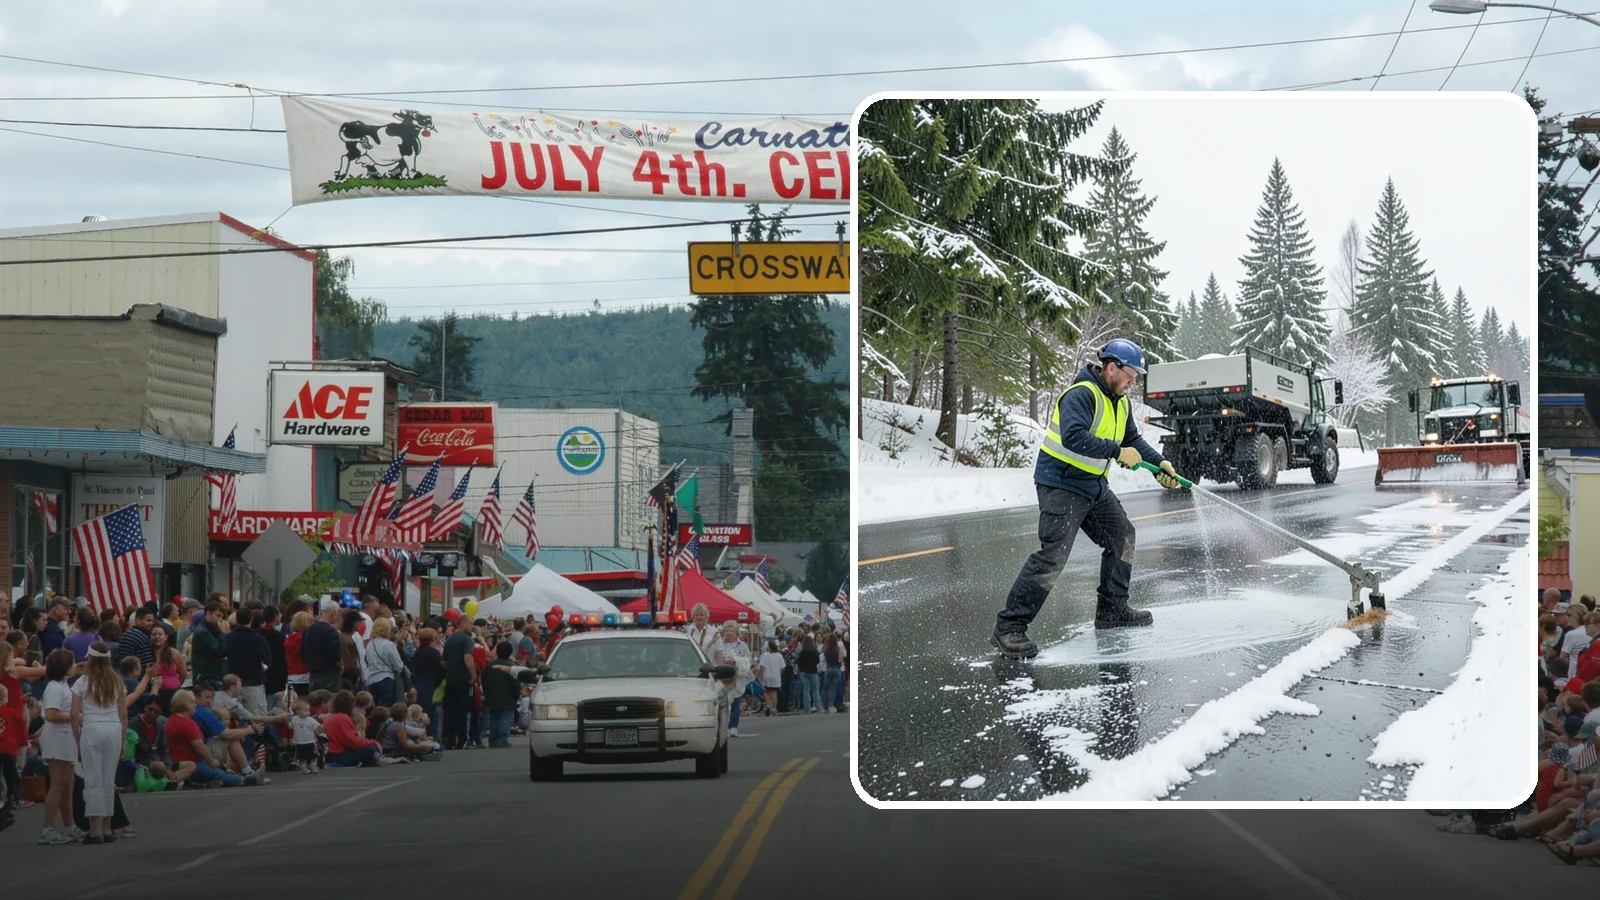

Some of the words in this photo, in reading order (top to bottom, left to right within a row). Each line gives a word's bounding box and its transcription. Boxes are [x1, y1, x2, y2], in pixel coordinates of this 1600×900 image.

[695, 121, 850, 150] Carnat
[481, 141, 605, 192] JULY
[632, 150, 746, 197] 4th.
[697, 254, 850, 280] CROSSWA
[283, 380, 373, 420] ACE
[406, 409, 452, 422] CEDAR
[461, 409, 485, 422] LOG
[283, 421, 370, 436] Hardware
[416, 428, 476, 446] Coca-Cola
[83, 485, 94, 494] St.
[95, 485, 124, 495] Vincent
[126, 486, 136, 495] de
[137, 486, 155, 495] Paul
[81, 503, 154, 522] THT
[213, 516, 331, 536] HARDARE
[688, 527, 741, 535] CRNATION
